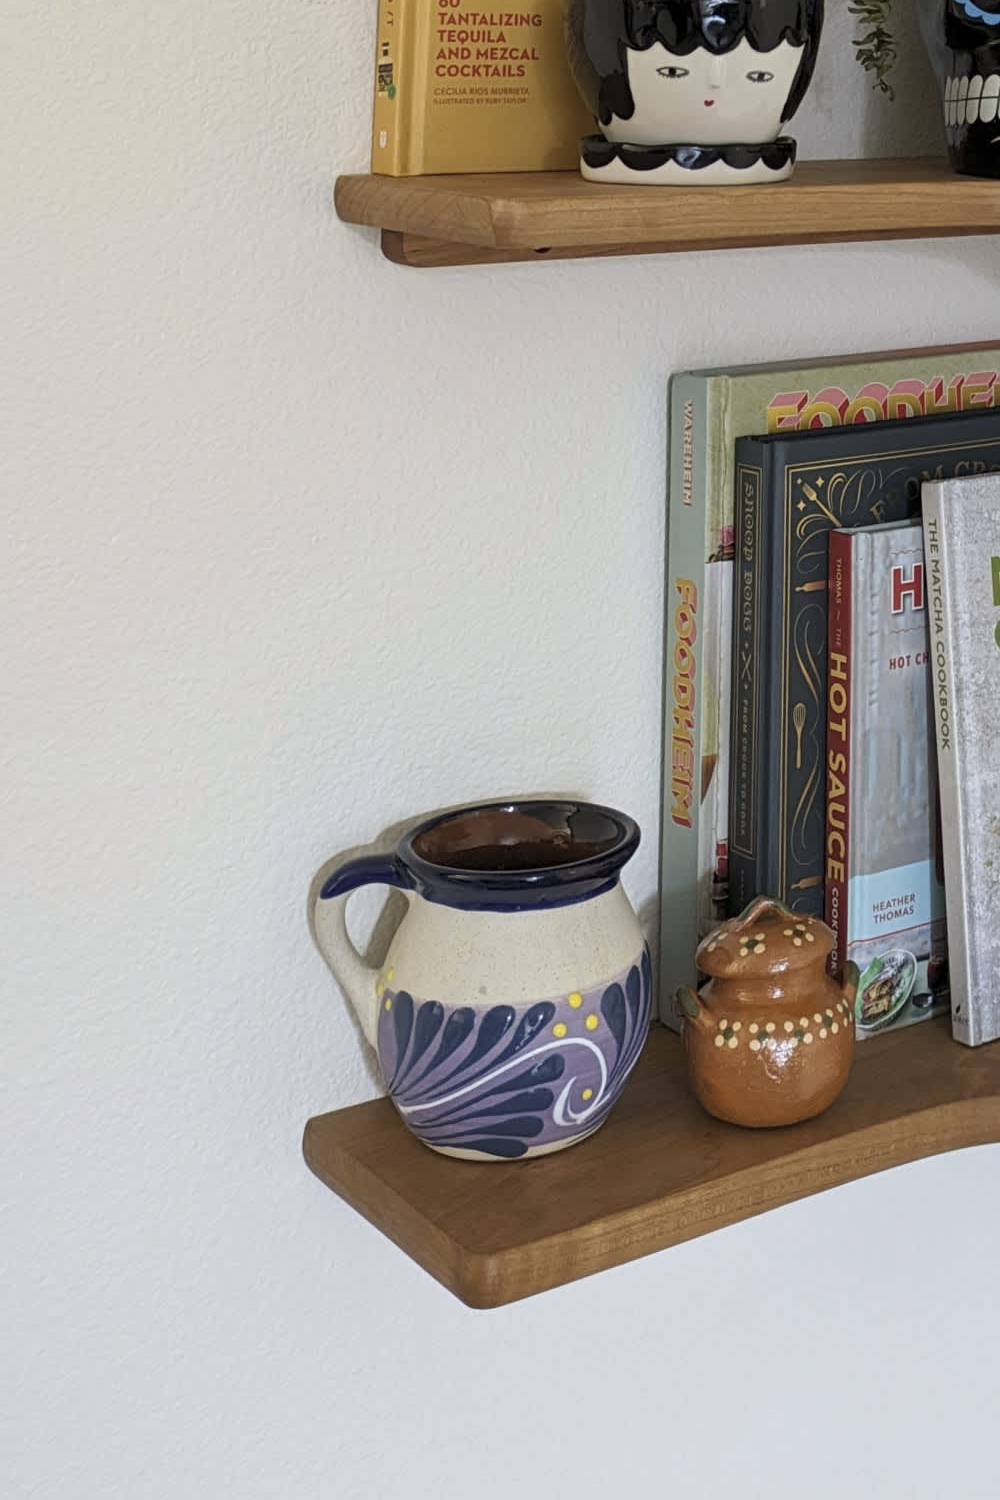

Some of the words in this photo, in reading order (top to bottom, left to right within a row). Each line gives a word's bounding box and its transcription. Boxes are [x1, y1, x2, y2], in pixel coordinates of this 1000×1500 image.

[385, 12, 395, 28] IT
[438, 12, 542, 27] TANTALIZING
[436, 30, 506, 44] TEQUILA
[436, 47, 471, 60] AND
[476, 48, 539, 61] MEZCAL
[435, 64, 525, 77] COCKTAILS
[433, 87, 467, 96] CECILIA
[683, 400, 693, 507] WAREHEIM
[743, 481, 754, 562] SNOOP
[928, 519, 939, 553] THE
[835, 558, 843, 604] THOMAS
[930, 559, 944, 635] MATCHA
[743, 571, 753, 631] DOGG
[889, 654, 912, 671] HOT
[671, 577, 698, 829] FOODHEIM
[829, 652, 847, 741] HOT
[935, 640, 950, 750] COOKBOOK
[827, 751, 847, 884] SAUCE
[872, 893, 916, 913] HEATHER
[873, 906, 914, 924] THOMAS
